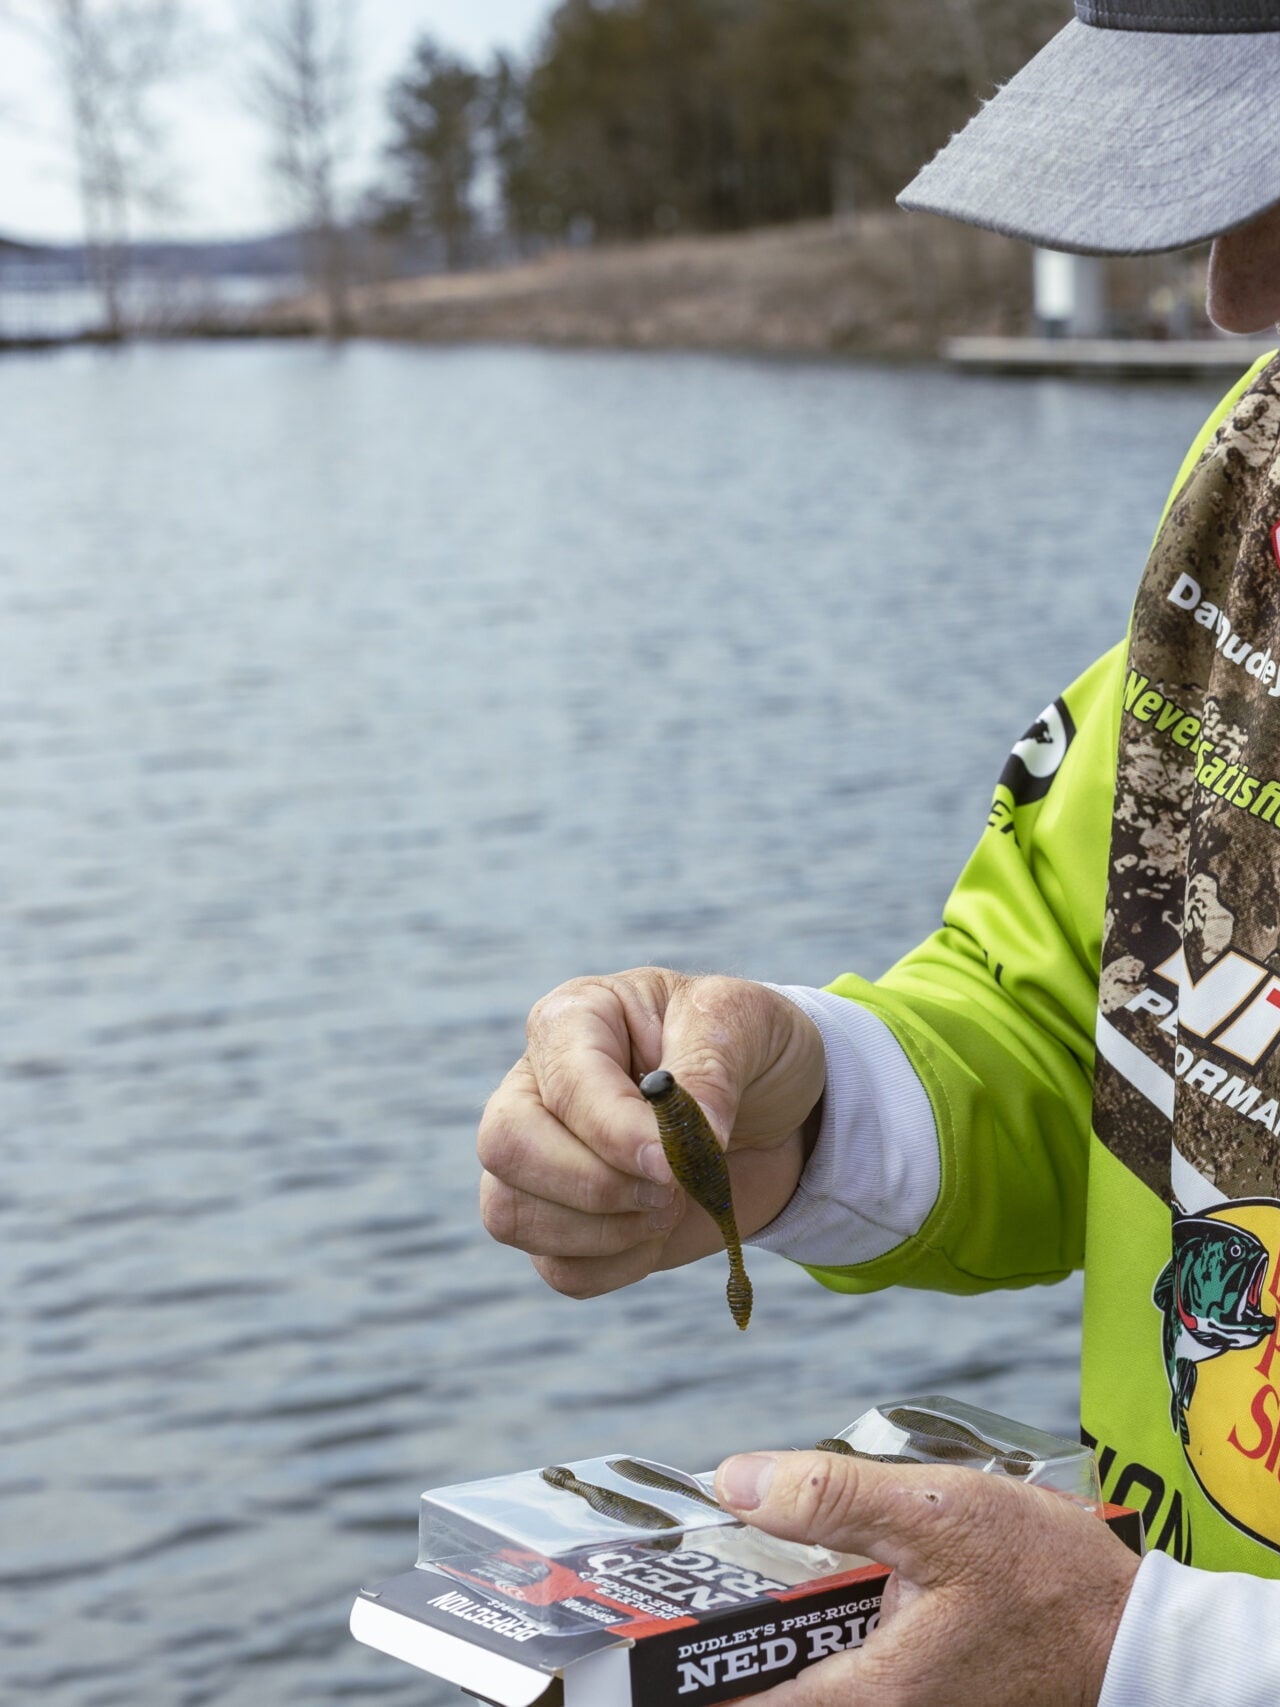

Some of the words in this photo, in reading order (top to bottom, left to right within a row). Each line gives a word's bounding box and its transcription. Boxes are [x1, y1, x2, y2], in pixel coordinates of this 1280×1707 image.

[427, 1590, 544, 1642] PERFECTION
[678, 1623, 776, 1659] DUDLEY'S
[781, 1595, 883, 1632] PRE-RIGGE
[677, 1636, 798, 1694] NED
